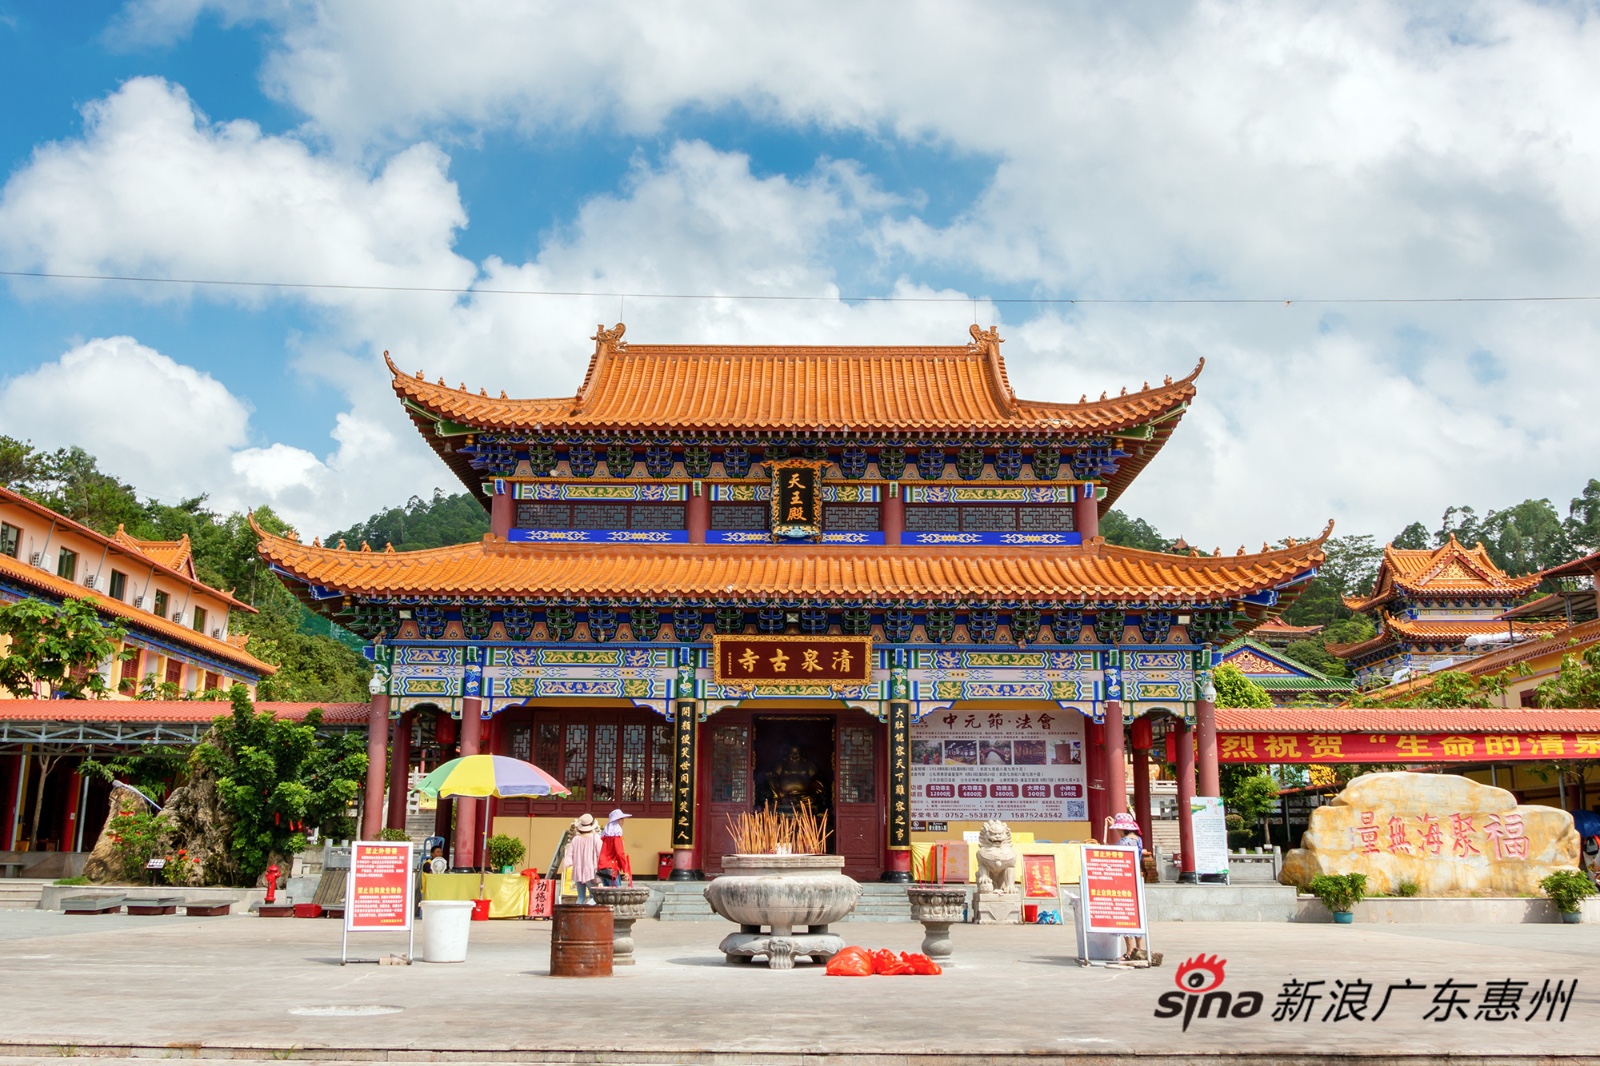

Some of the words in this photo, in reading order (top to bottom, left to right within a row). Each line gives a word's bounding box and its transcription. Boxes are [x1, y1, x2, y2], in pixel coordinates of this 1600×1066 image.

[786, 473, 807, 522] 天王殿
[738, 648, 854, 673] 清泉古寺
[1193, 733, 1600, 759] 烈祝贺“生命的清泉
[532, 881, 547, 915] 功德箱
